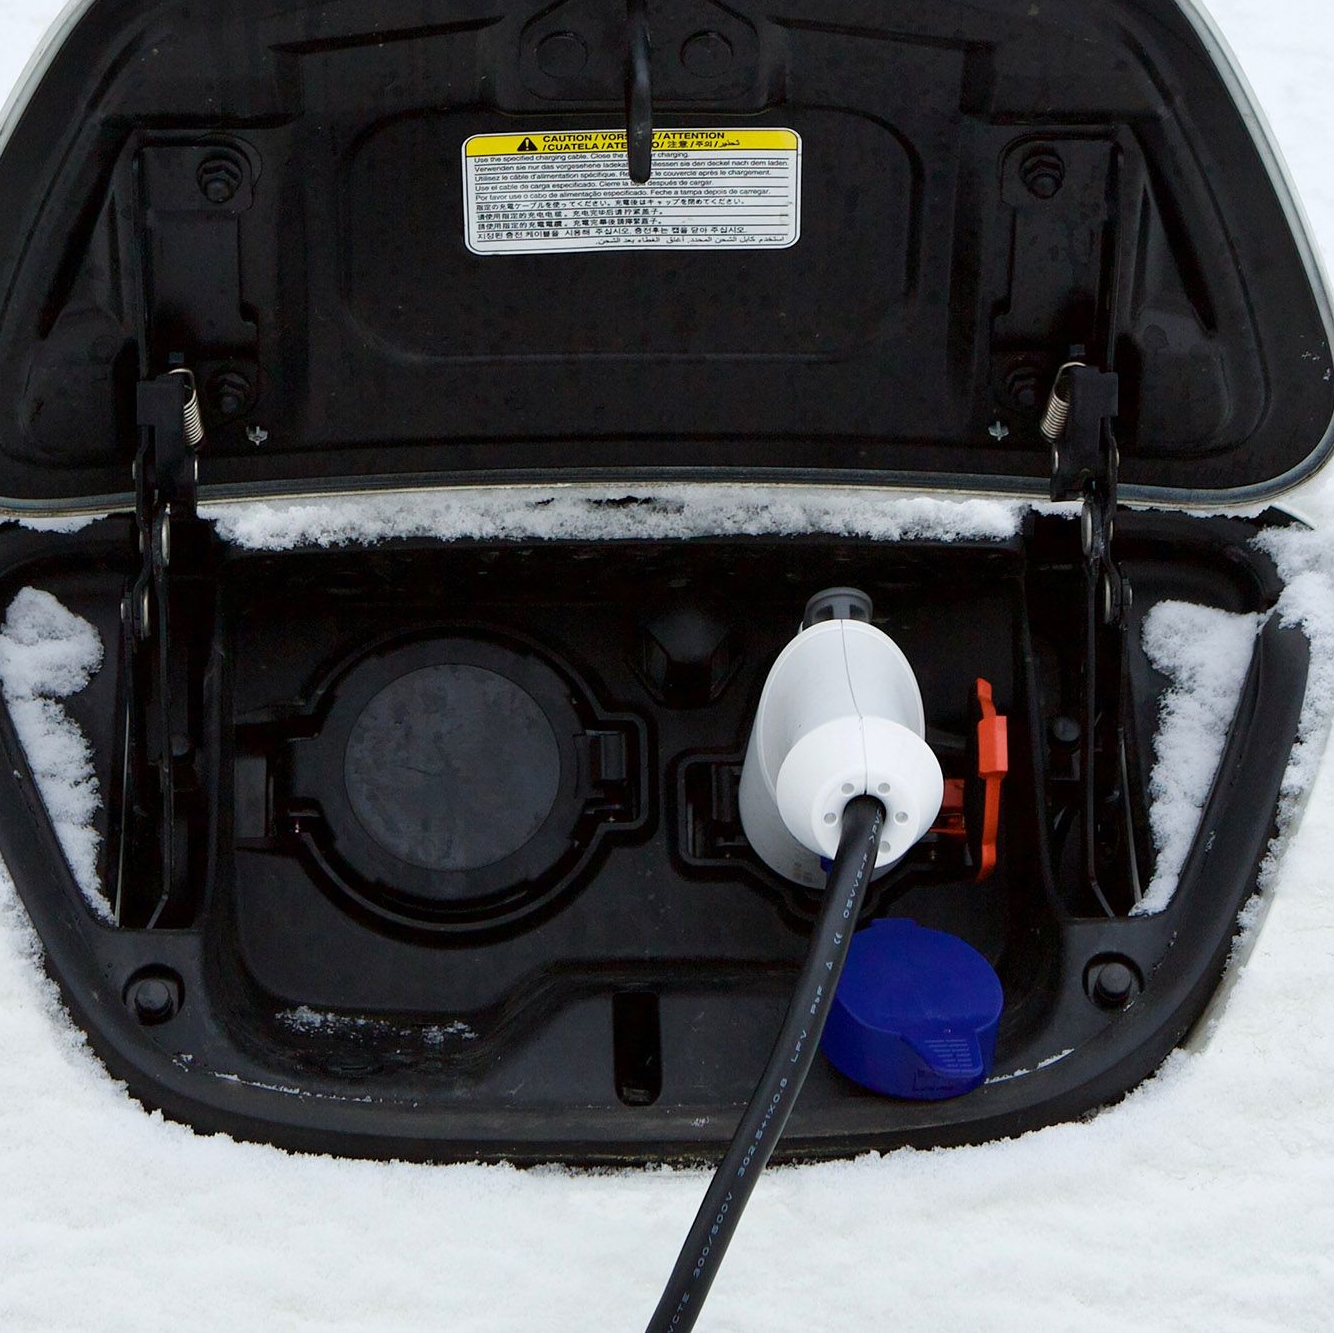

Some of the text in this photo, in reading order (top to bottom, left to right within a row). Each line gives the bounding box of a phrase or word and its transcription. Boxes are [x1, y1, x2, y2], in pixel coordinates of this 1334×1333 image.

[502, 155, 534, 163] specified
[555, 162, 601, 170] vorgesehene
[530, 172, 578, 180] d'alimentation
[579, 171, 617, 179] spécifique.
[551, 181, 597, 189] especificado.
[603, 189, 648, 197] especificado.
[693, 1191, 733, 1277] 300/500V
